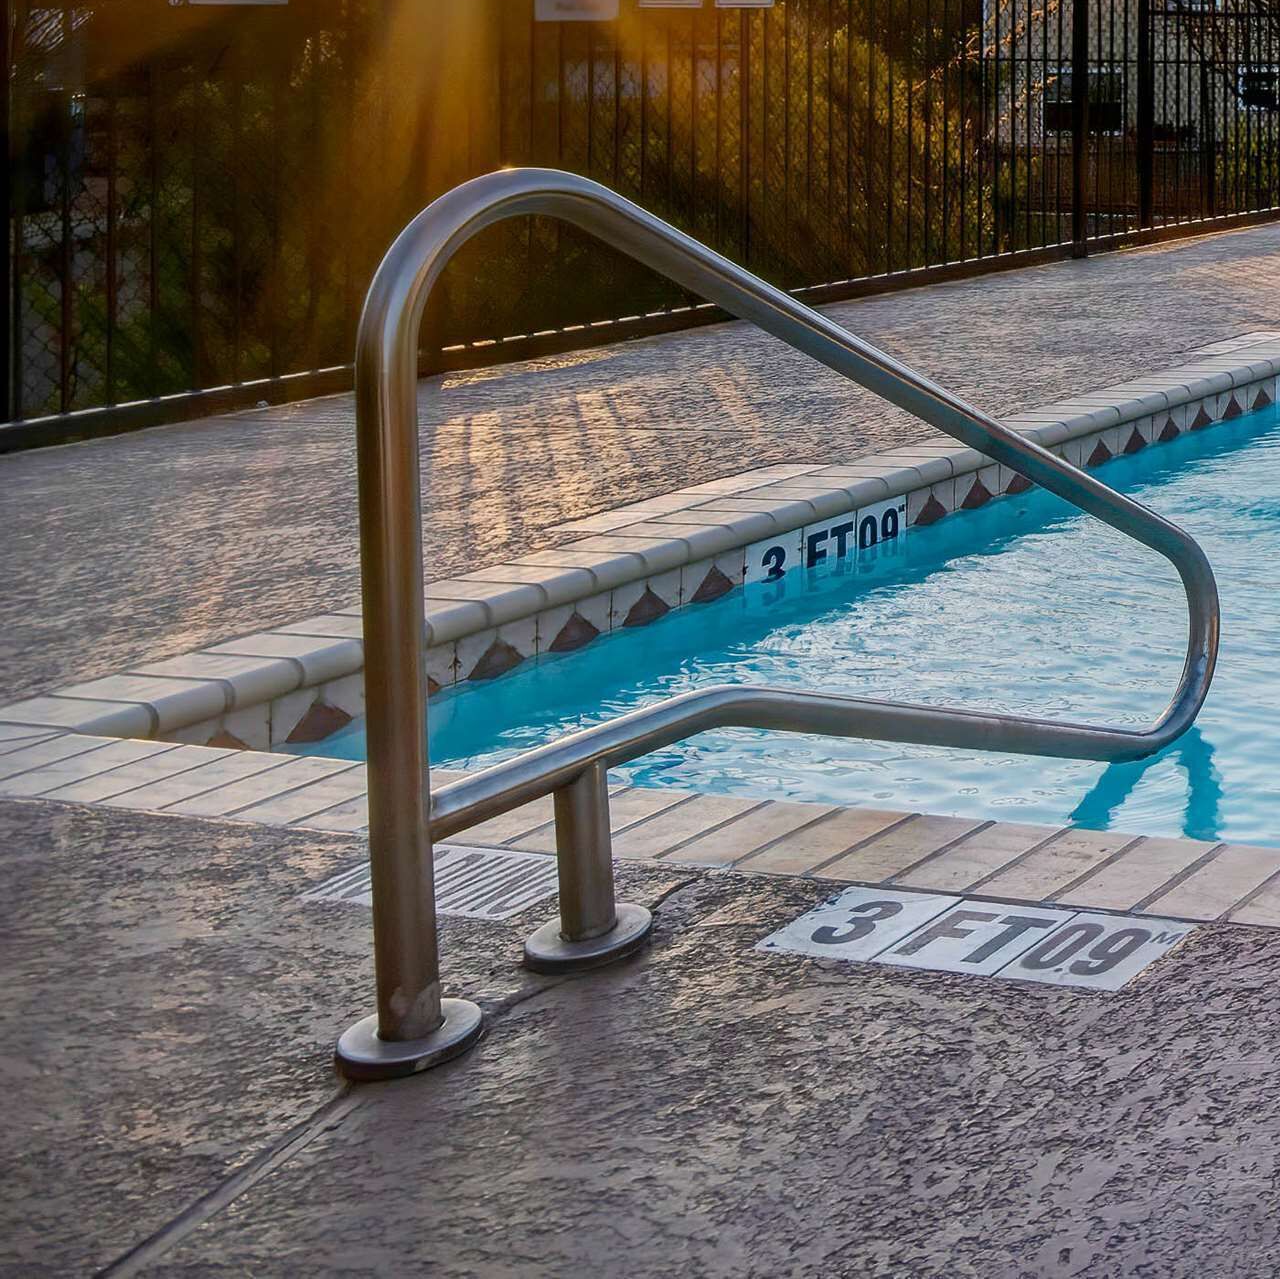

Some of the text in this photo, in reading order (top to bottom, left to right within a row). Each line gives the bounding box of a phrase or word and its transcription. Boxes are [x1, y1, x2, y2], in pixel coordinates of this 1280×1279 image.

[761, 545, 786, 584] 3
[806, 520, 854, 570] FT
[810, 900, 904, 945] 3
[892, 909, 1062, 964] FT
